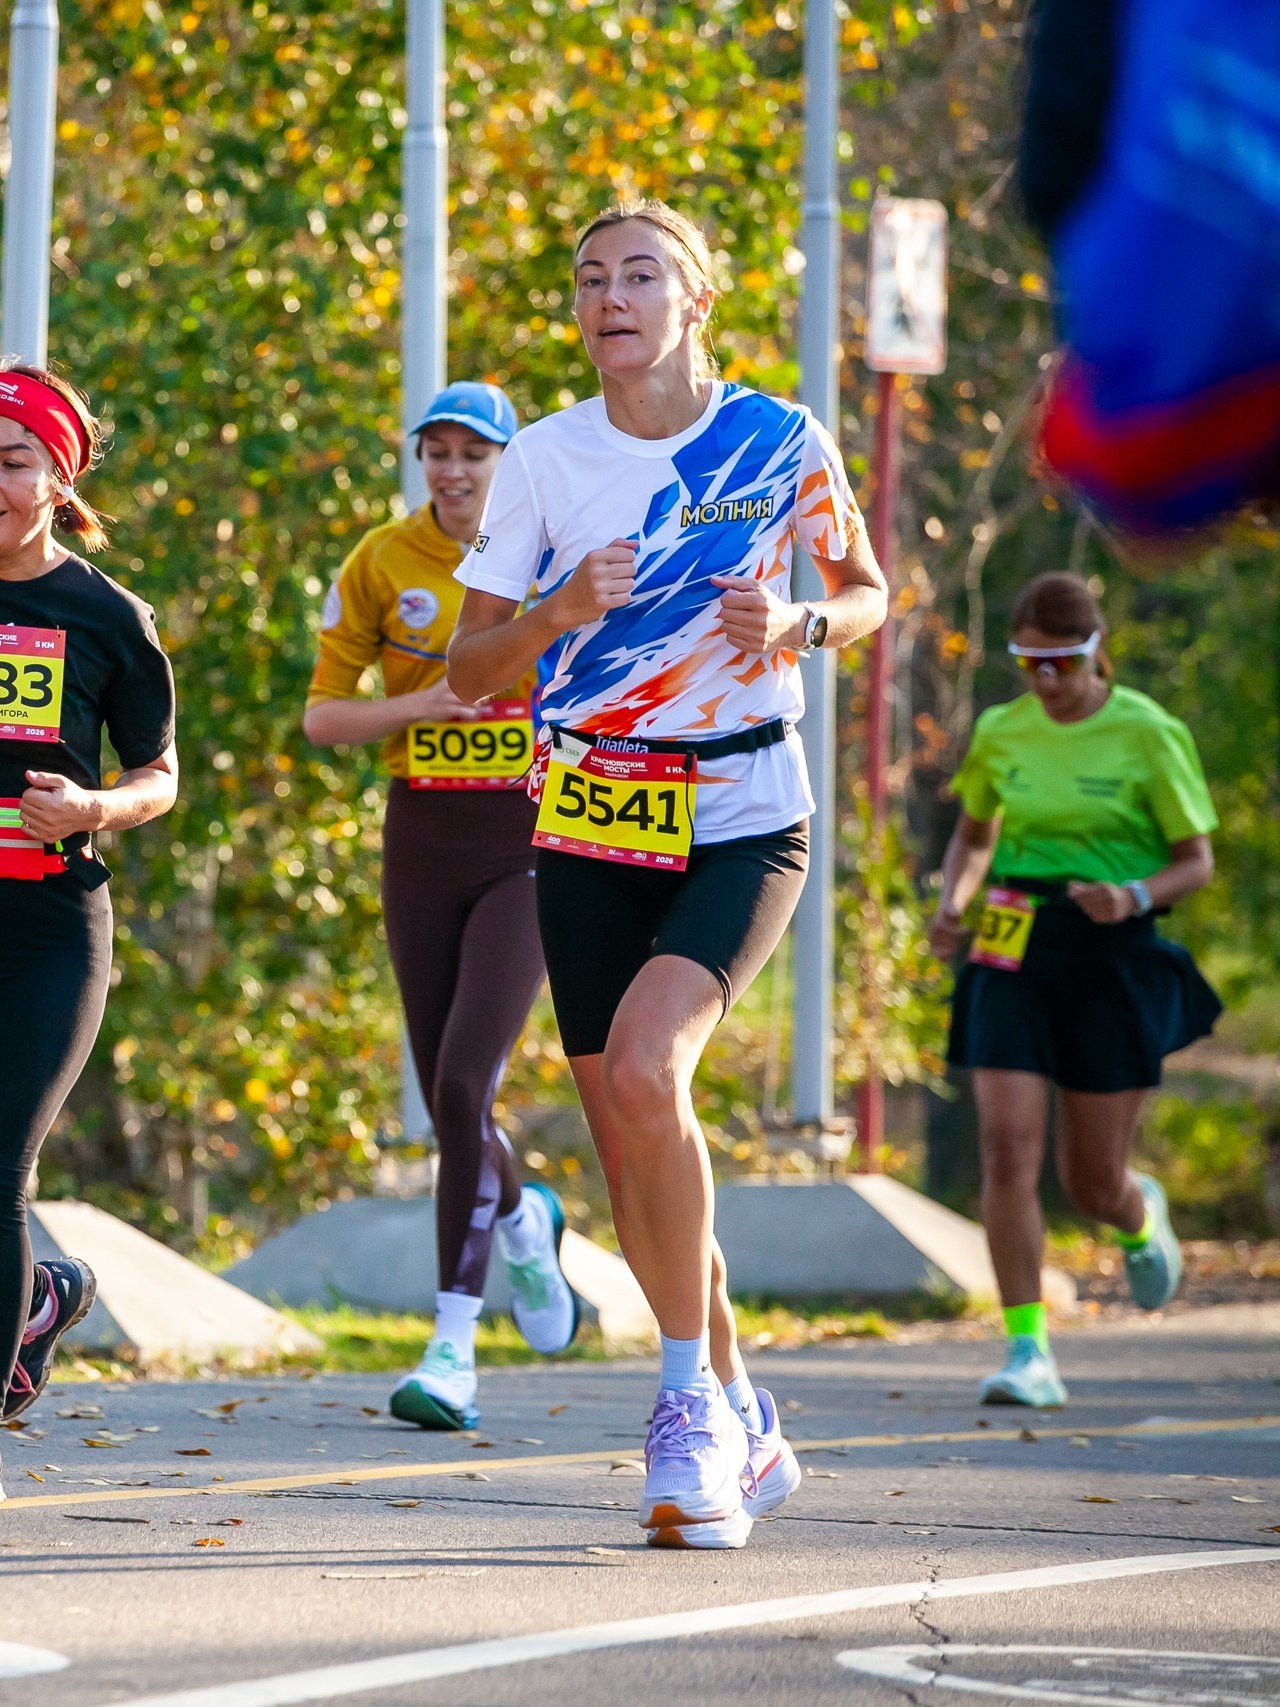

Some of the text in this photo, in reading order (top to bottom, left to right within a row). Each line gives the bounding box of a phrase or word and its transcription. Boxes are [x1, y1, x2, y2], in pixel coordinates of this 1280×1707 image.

[680, 496, 774, 528] МОЛНИЯ
[35, 640, 41, 648] 5
[25, 728, 45, 736] 2026
[414, 727, 527, 762] 5099
[596, 735, 649, 754] Triatleta
[590, 755, 646, 768] КРАСНОЯРСКИЕ
[603, 765, 630, 774] МОСТЫ
[555, 771, 680, 835] 5541
[655, 855, 674, 864] 2026
